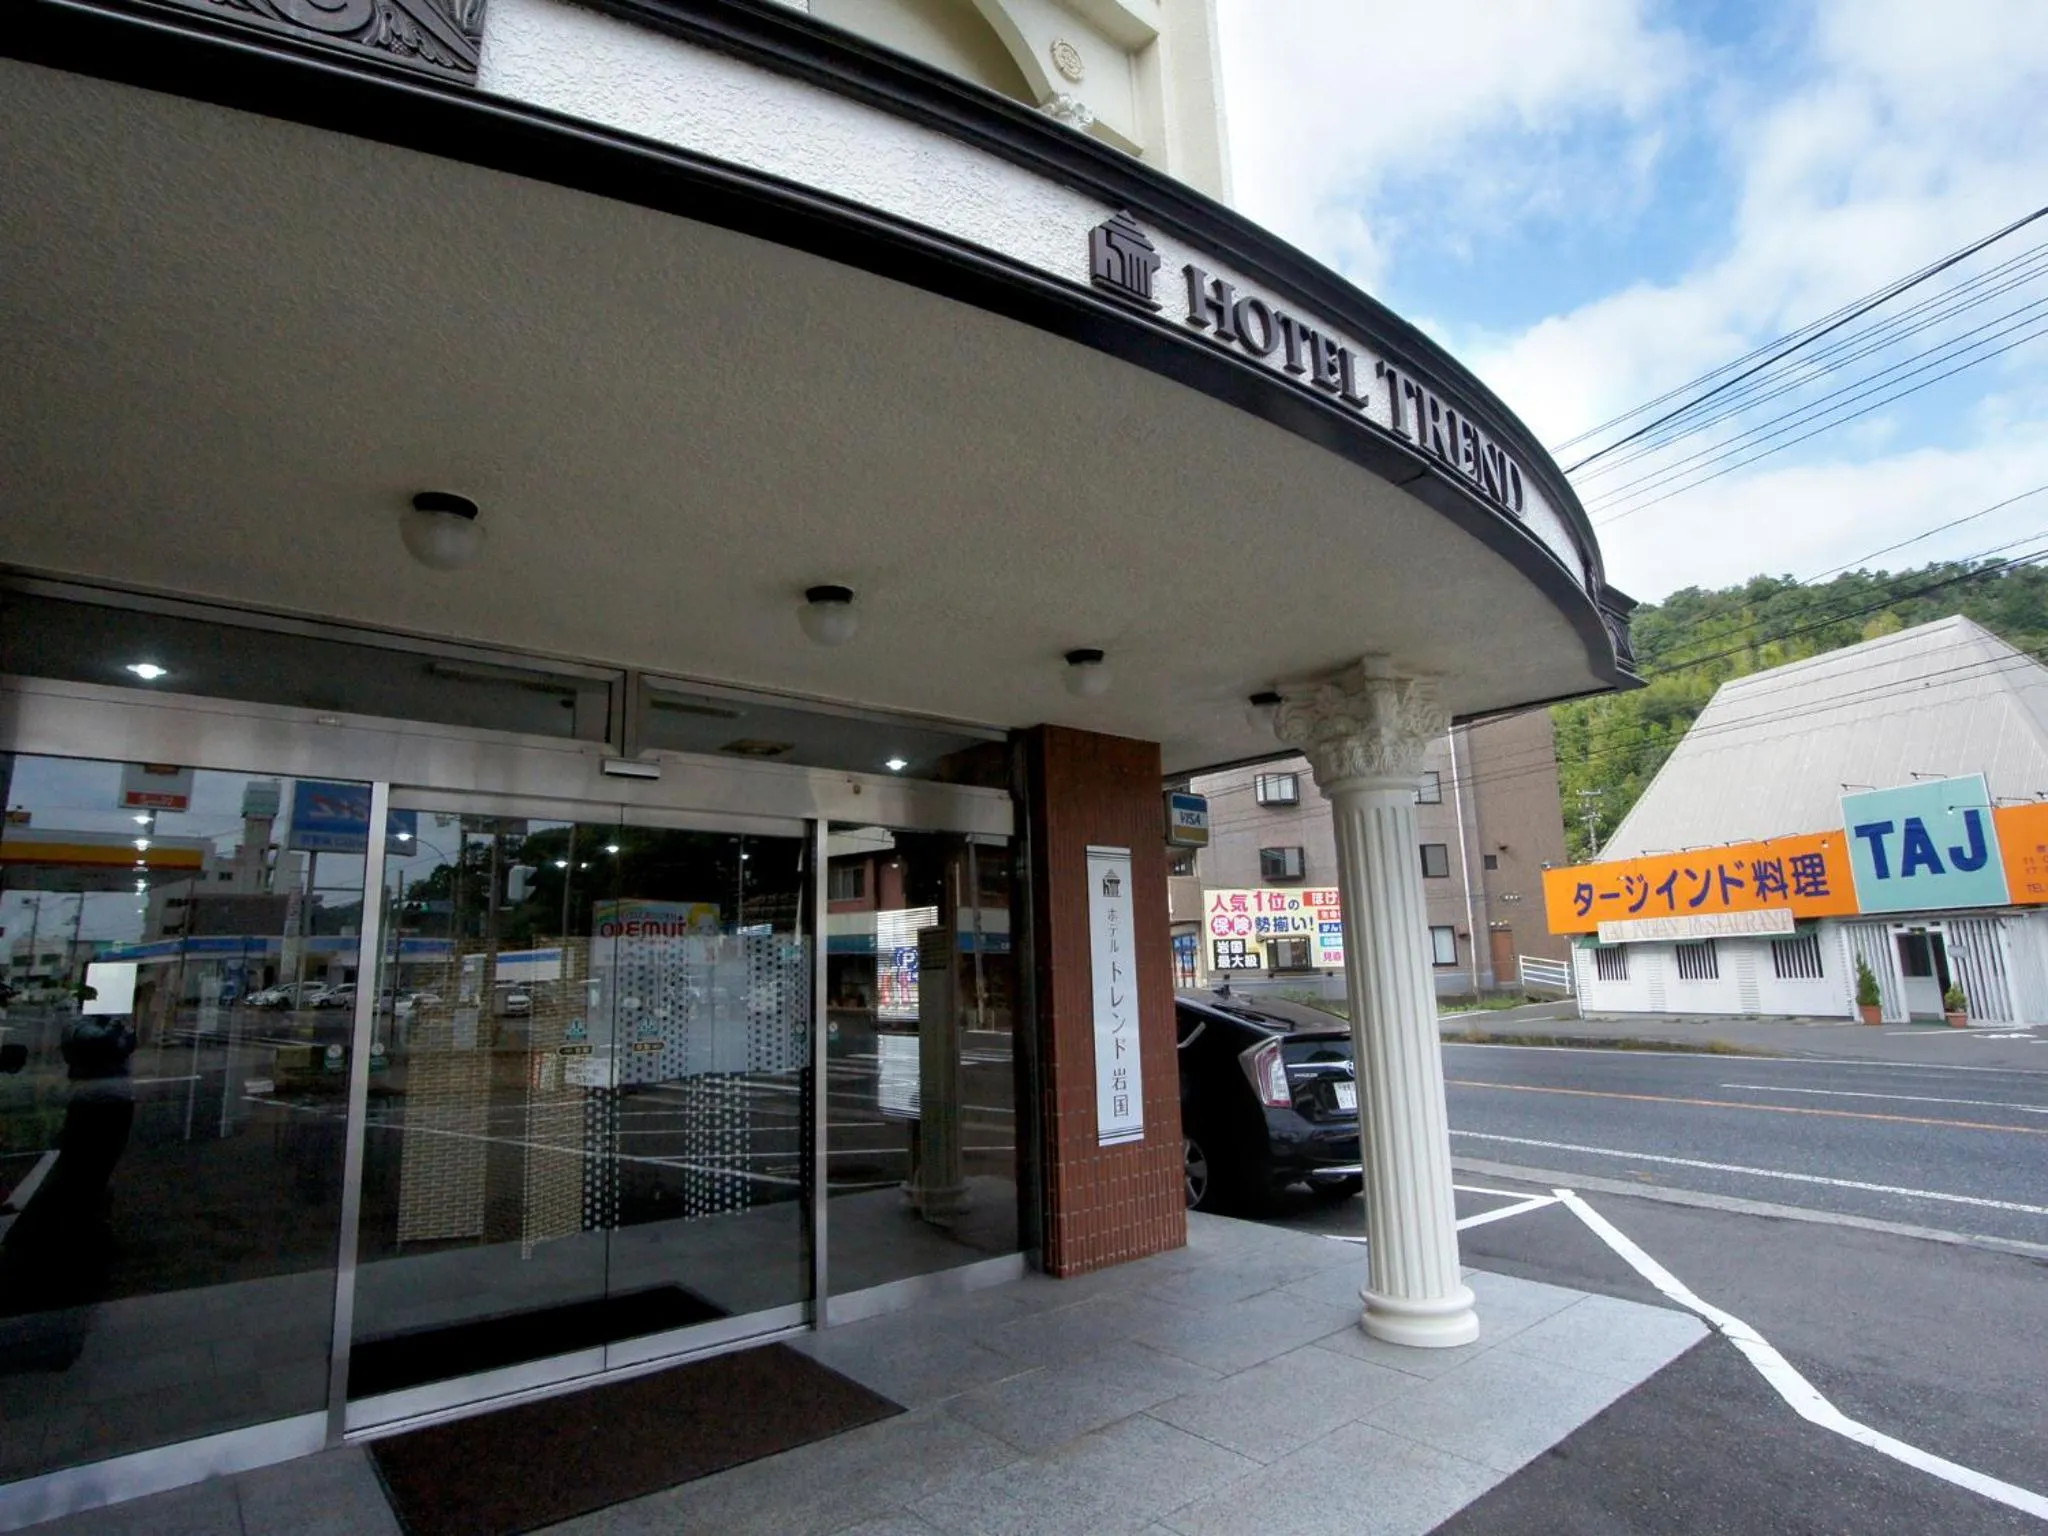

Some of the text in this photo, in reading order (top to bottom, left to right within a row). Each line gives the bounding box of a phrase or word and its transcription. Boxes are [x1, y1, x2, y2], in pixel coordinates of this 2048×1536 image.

[1182, 263, 1524, 519] HOTEL TREND
[1854, 809, 1988, 880] TAJ
[1211, 890, 1300, 913] 人気1位の
[1312, 891, 1341, 906] ほけ
[1574, 852, 1831, 917] タージインド料理
[1106, 908, 1129, 1117] ホテルトレンド岩国
